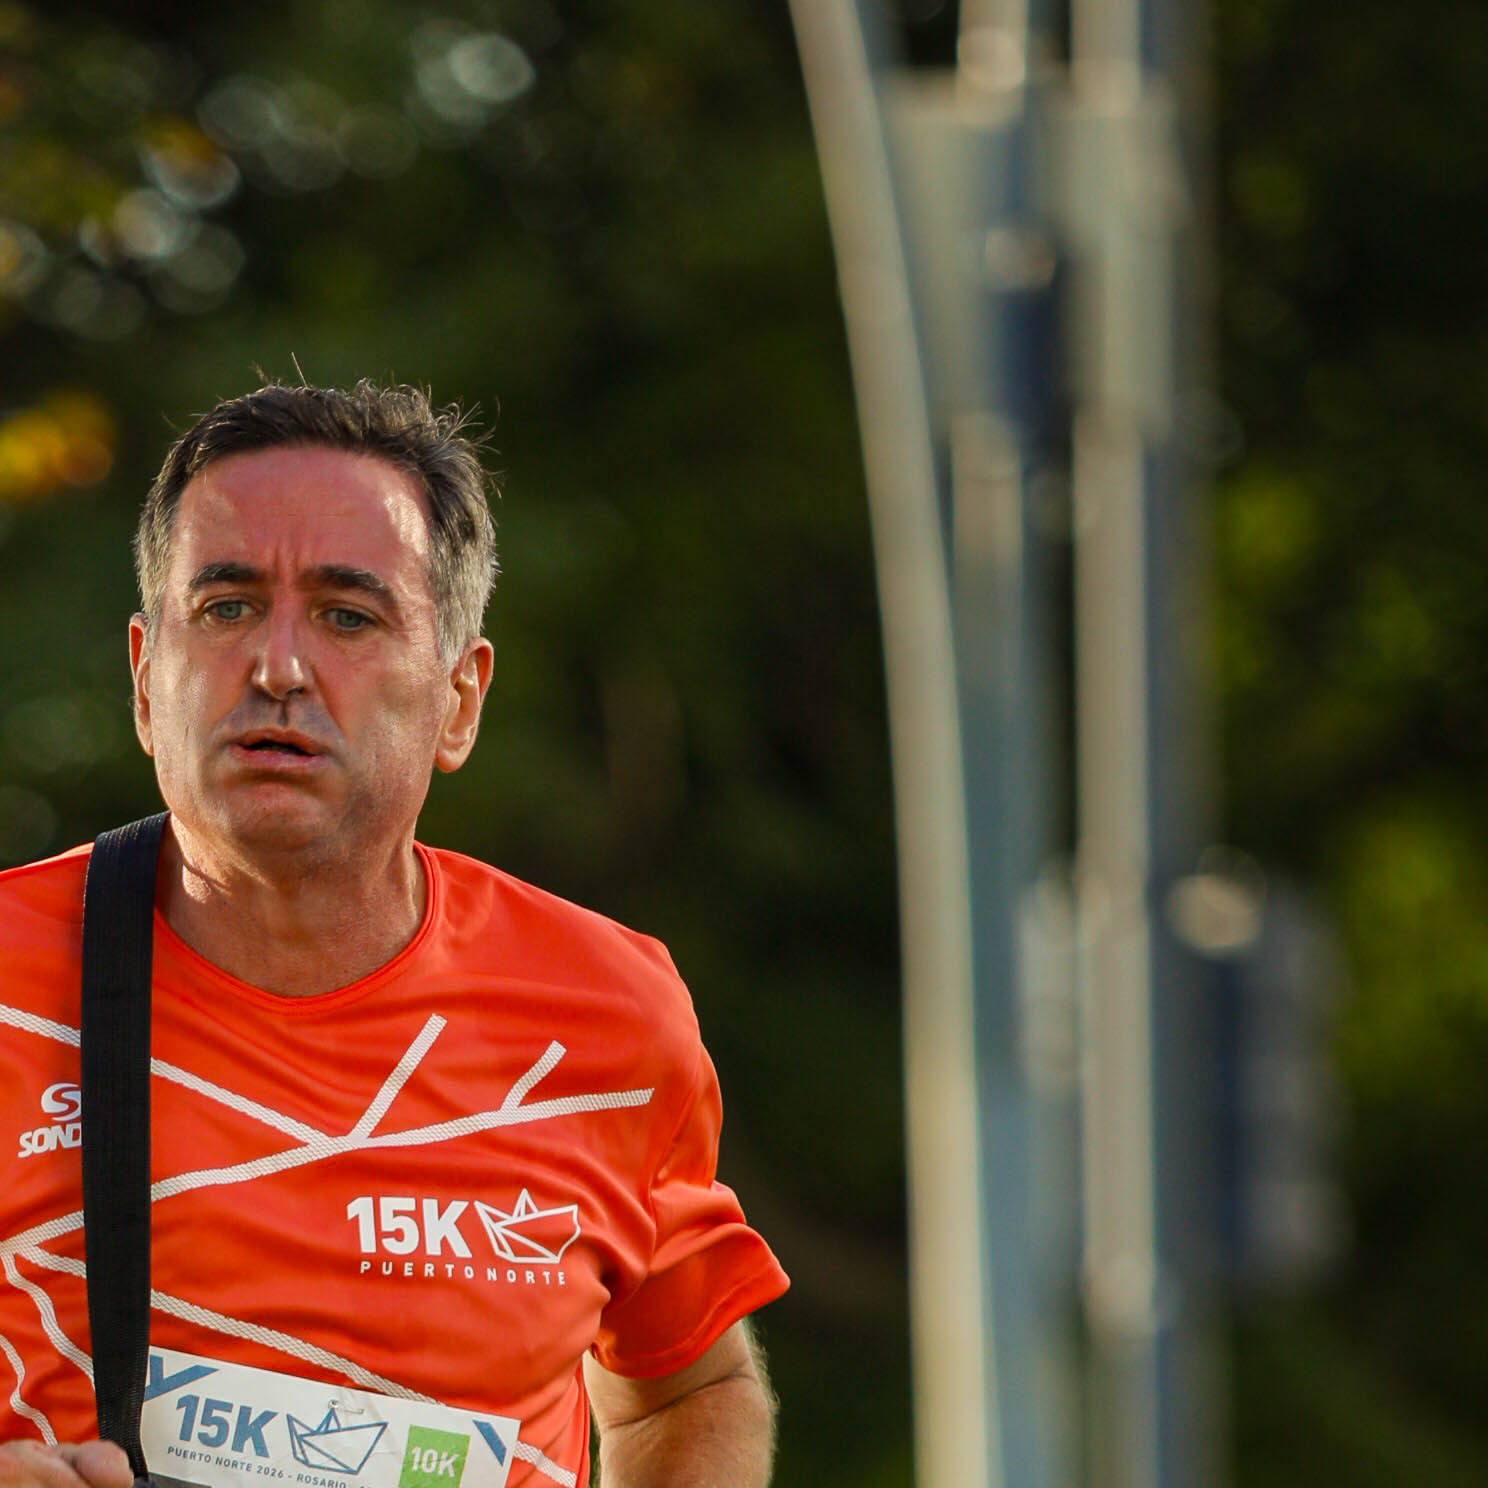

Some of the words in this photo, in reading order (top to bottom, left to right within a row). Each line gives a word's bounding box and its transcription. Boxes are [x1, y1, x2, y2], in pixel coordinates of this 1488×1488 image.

[346, 1196, 473, 1258] 15K
[175, 1394, 279, 1458] 15K
[167, 1446, 212, 1464] PUERTO
[215, 1454, 253, 1472] NORTE
[256, 1465, 284, 1479] 2026
[410, 1446, 461, 1479] 10K
